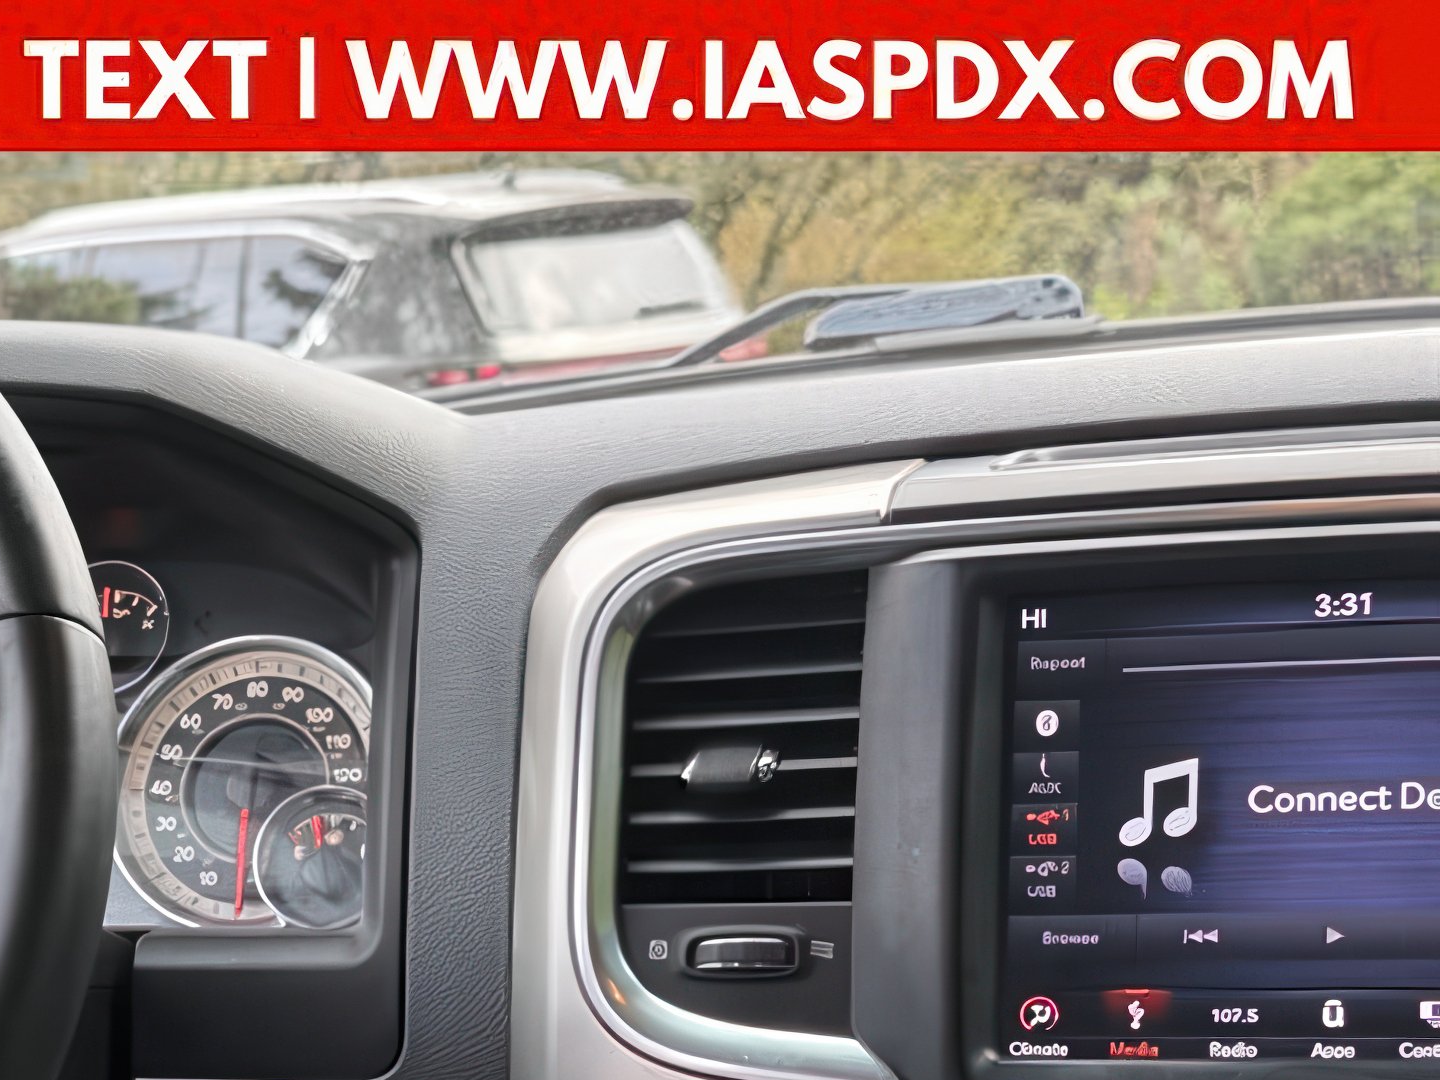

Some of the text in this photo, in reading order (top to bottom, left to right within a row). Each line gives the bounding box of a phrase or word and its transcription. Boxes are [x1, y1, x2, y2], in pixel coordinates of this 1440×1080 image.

[1314, 591, 1373, 618] 3:31
[1021, 608, 1048, 630] HI
[212, 693, 234, 710] 70
[1247, 784, 1392, 814] Connect
[1211, 1008, 1260, 1023] 107.5
